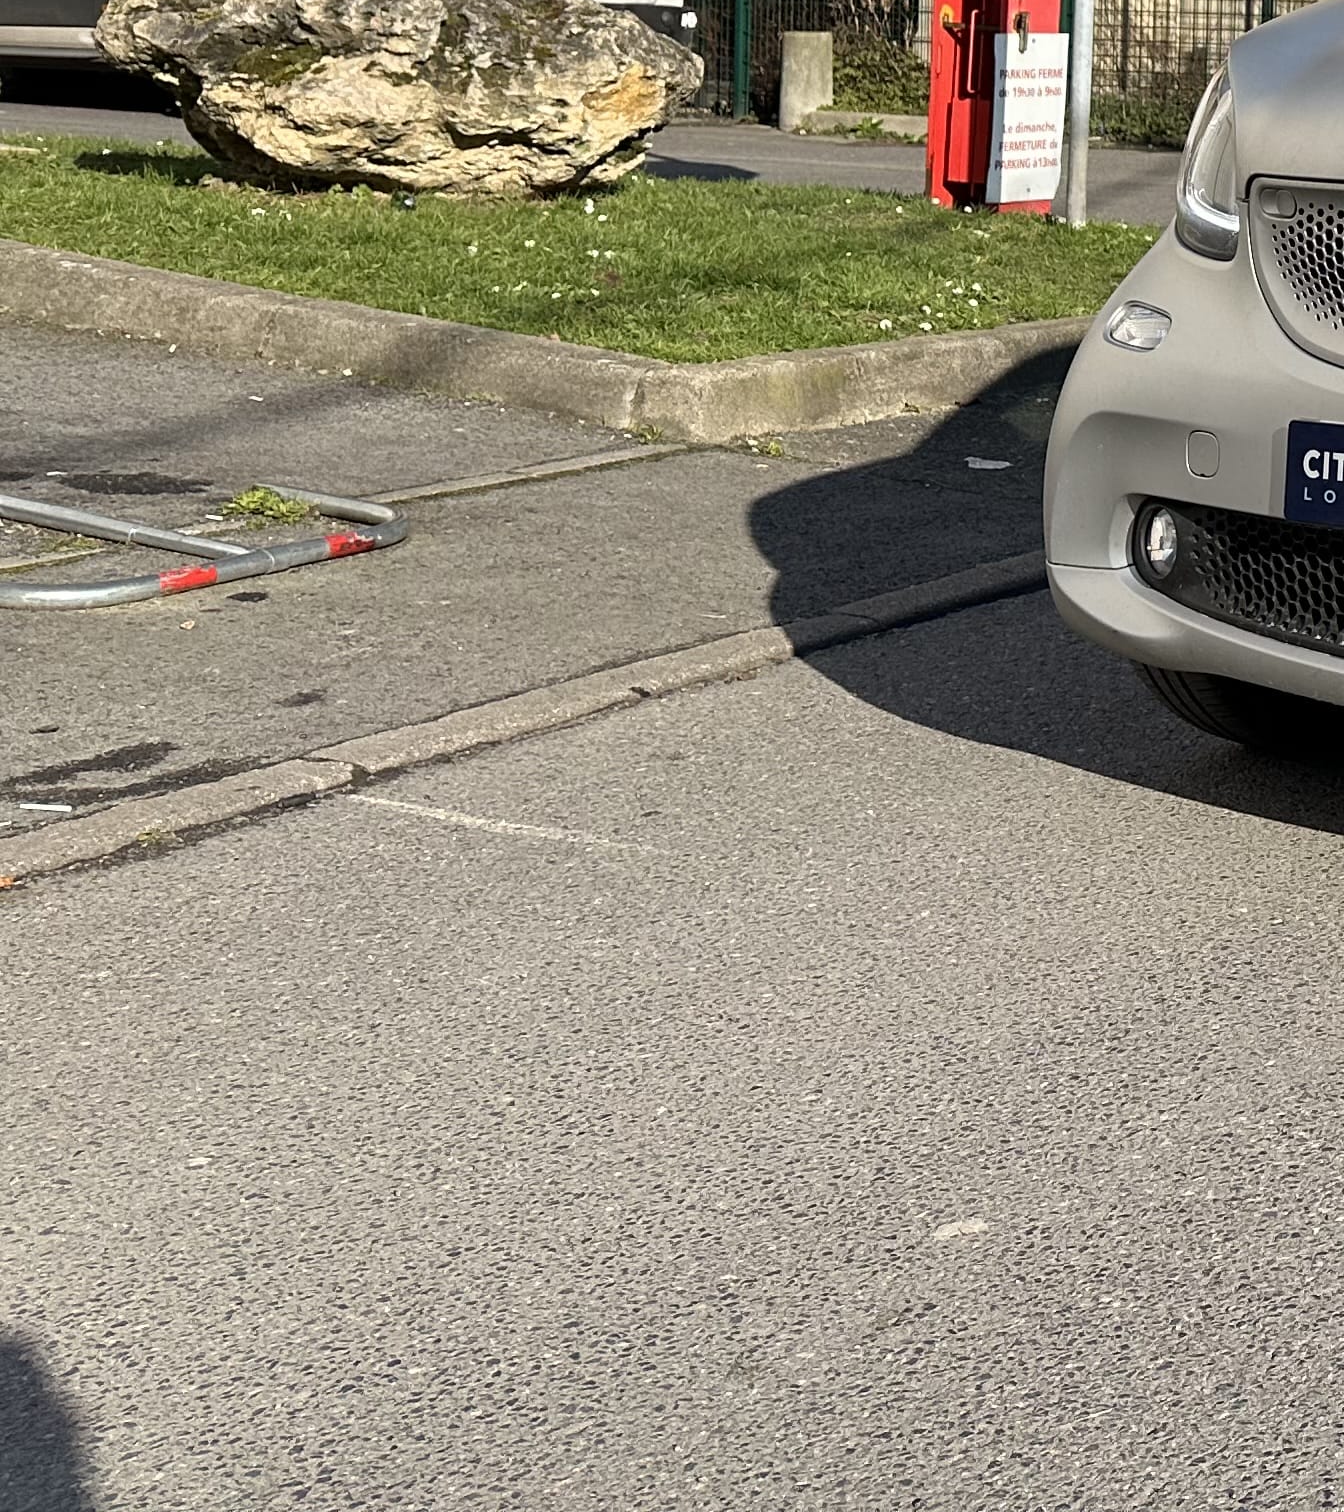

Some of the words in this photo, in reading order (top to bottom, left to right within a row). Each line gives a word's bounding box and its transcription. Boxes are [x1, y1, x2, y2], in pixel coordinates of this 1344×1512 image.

[1000, 69, 1036, 79] PARKING
[999, 140, 1047, 152] FERMETURE
[995, 158, 1030, 170] PARKING
